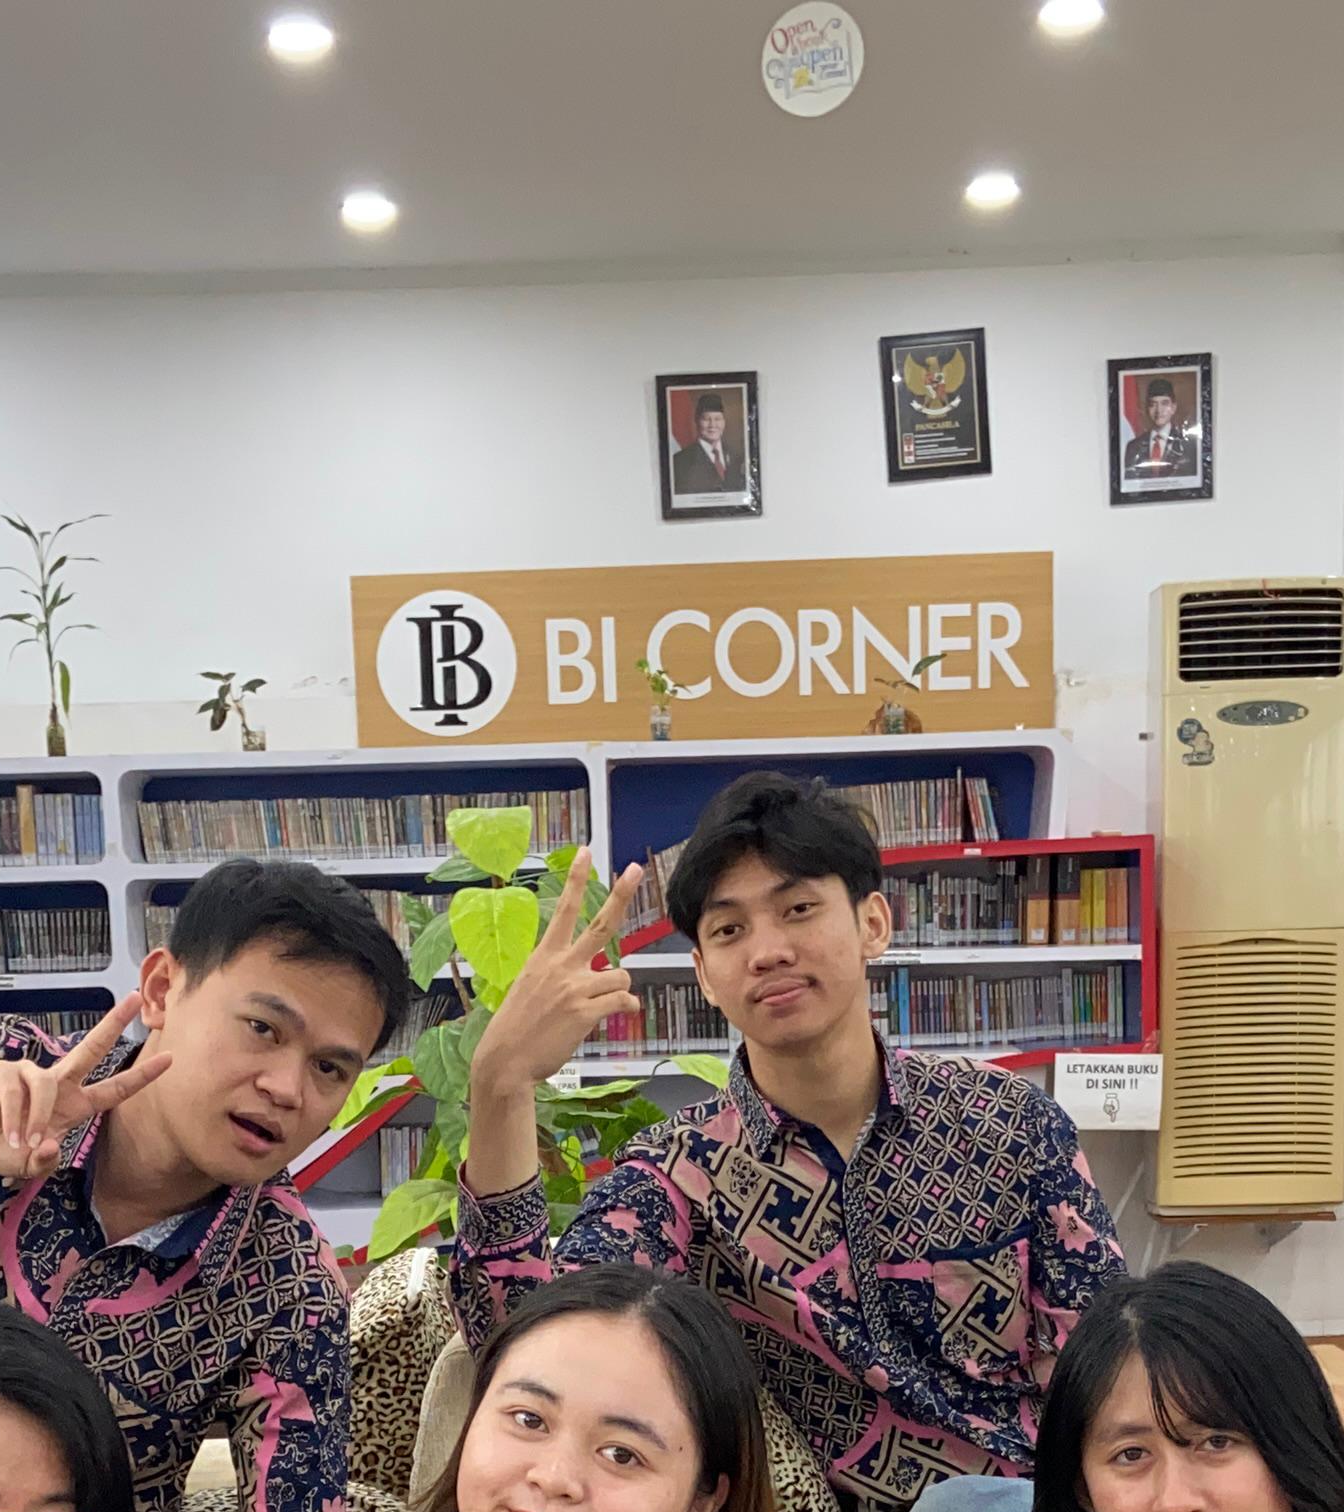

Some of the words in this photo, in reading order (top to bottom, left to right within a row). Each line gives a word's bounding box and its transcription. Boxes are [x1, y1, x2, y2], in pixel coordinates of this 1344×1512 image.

[771, 19, 816, 55] Open
[545, 616, 617, 705] BI
[646, 602, 1030, 700] CORNER
[1067, 1063, 1124, 1074] LETAKKAN
[1127, 1064, 1159, 1074] BUKU
[1086, 1078, 1099, 1089] DI
[1102, 1078, 1126, 1089] SINI
